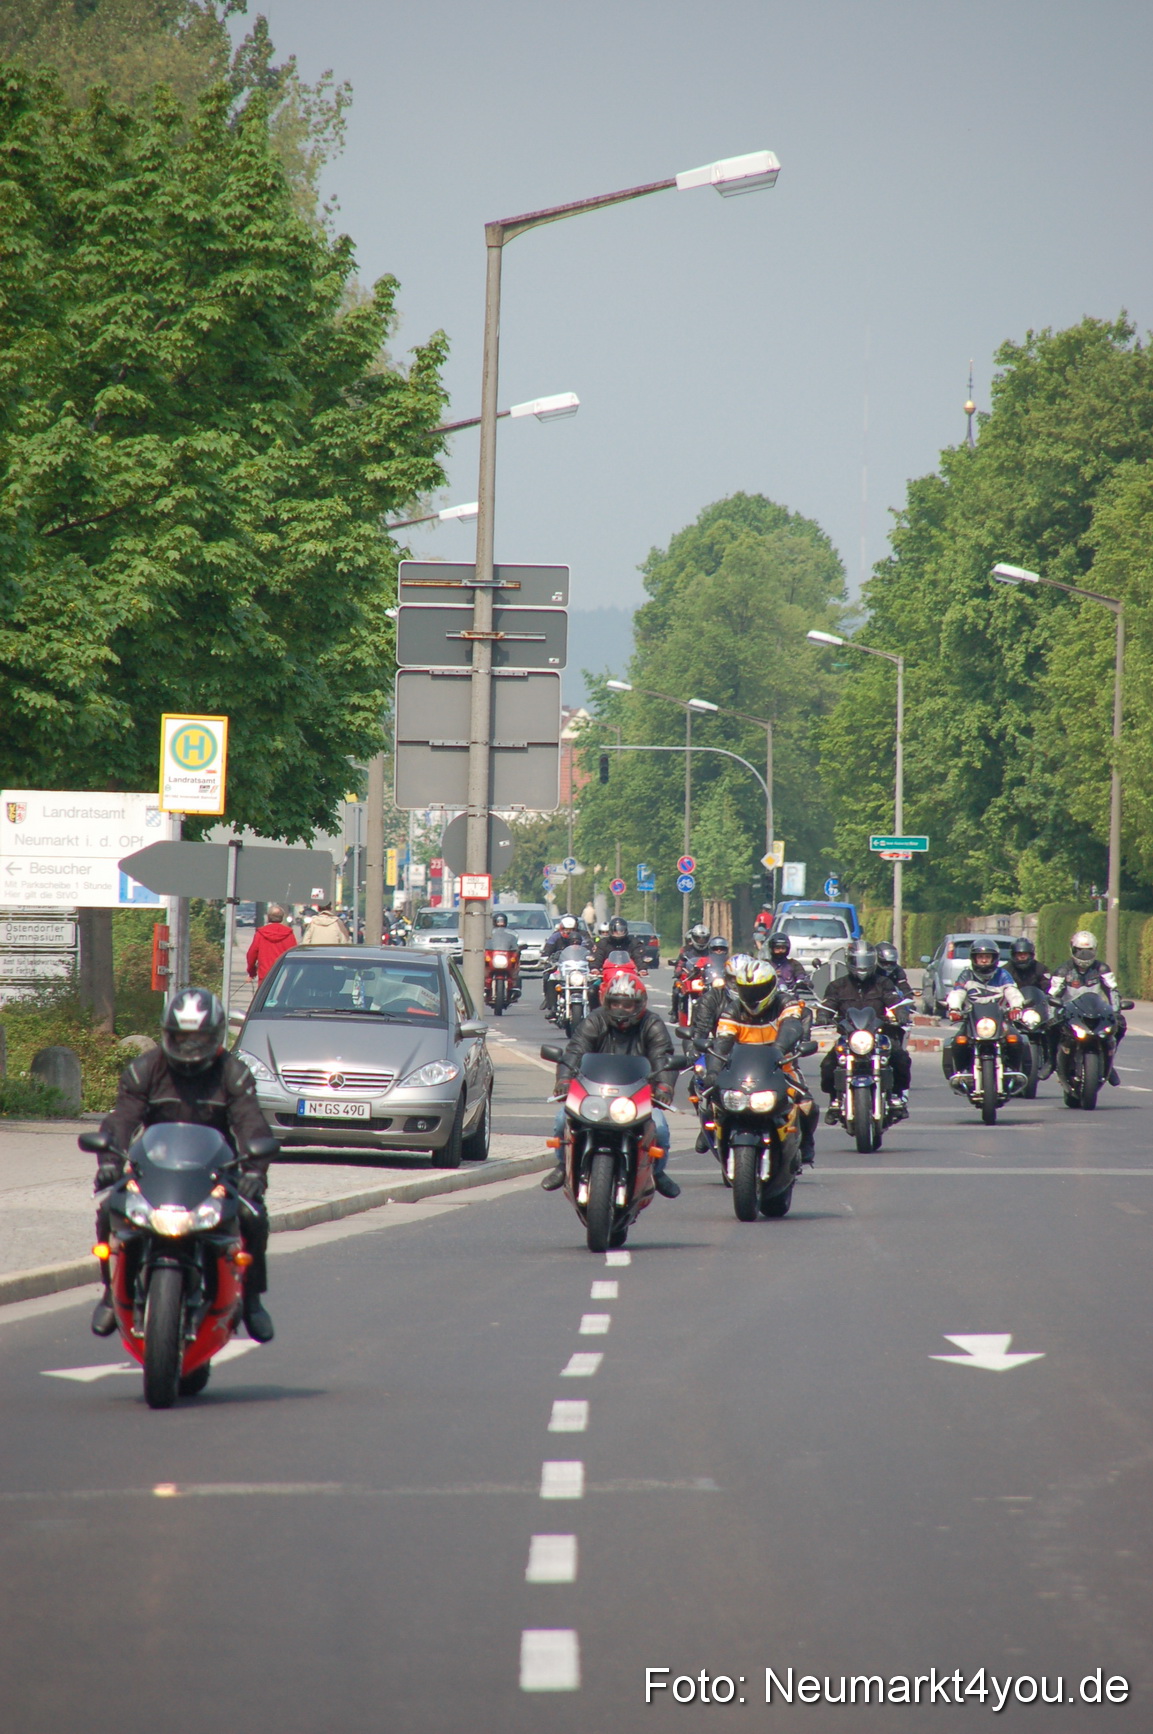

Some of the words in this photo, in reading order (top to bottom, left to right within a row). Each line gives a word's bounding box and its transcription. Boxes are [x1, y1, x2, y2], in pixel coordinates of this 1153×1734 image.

[182, 734, 205, 760] H
[168, 776, 216, 785] Landratsamt
[42, 806, 126, 820] Landratsamt
[14, 833, 80, 847] Neumarkt
[86, 835, 93, 847] i.
[99, 836, 112, 847] d.
[29, 861, 93, 875] Besucher
[4, 880, 18, 888] Mit
[21, 880, 72, 890] Parkscheibe
[83, 881, 113, 890] Stunde
[4, 890, 21, 898] Hier
[24, 891, 37, 900] gilt
[40, 891, 53, 899] die
[56, 891, 79, 899] StVO
[6, 923, 65, 932] Ostendorfer
[6, 932, 64, 943] Gymnasium
[309, 1102, 317, 1114] N
[324, 1103, 340, 1115] GS
[342, 1104, 365, 1116] 490
